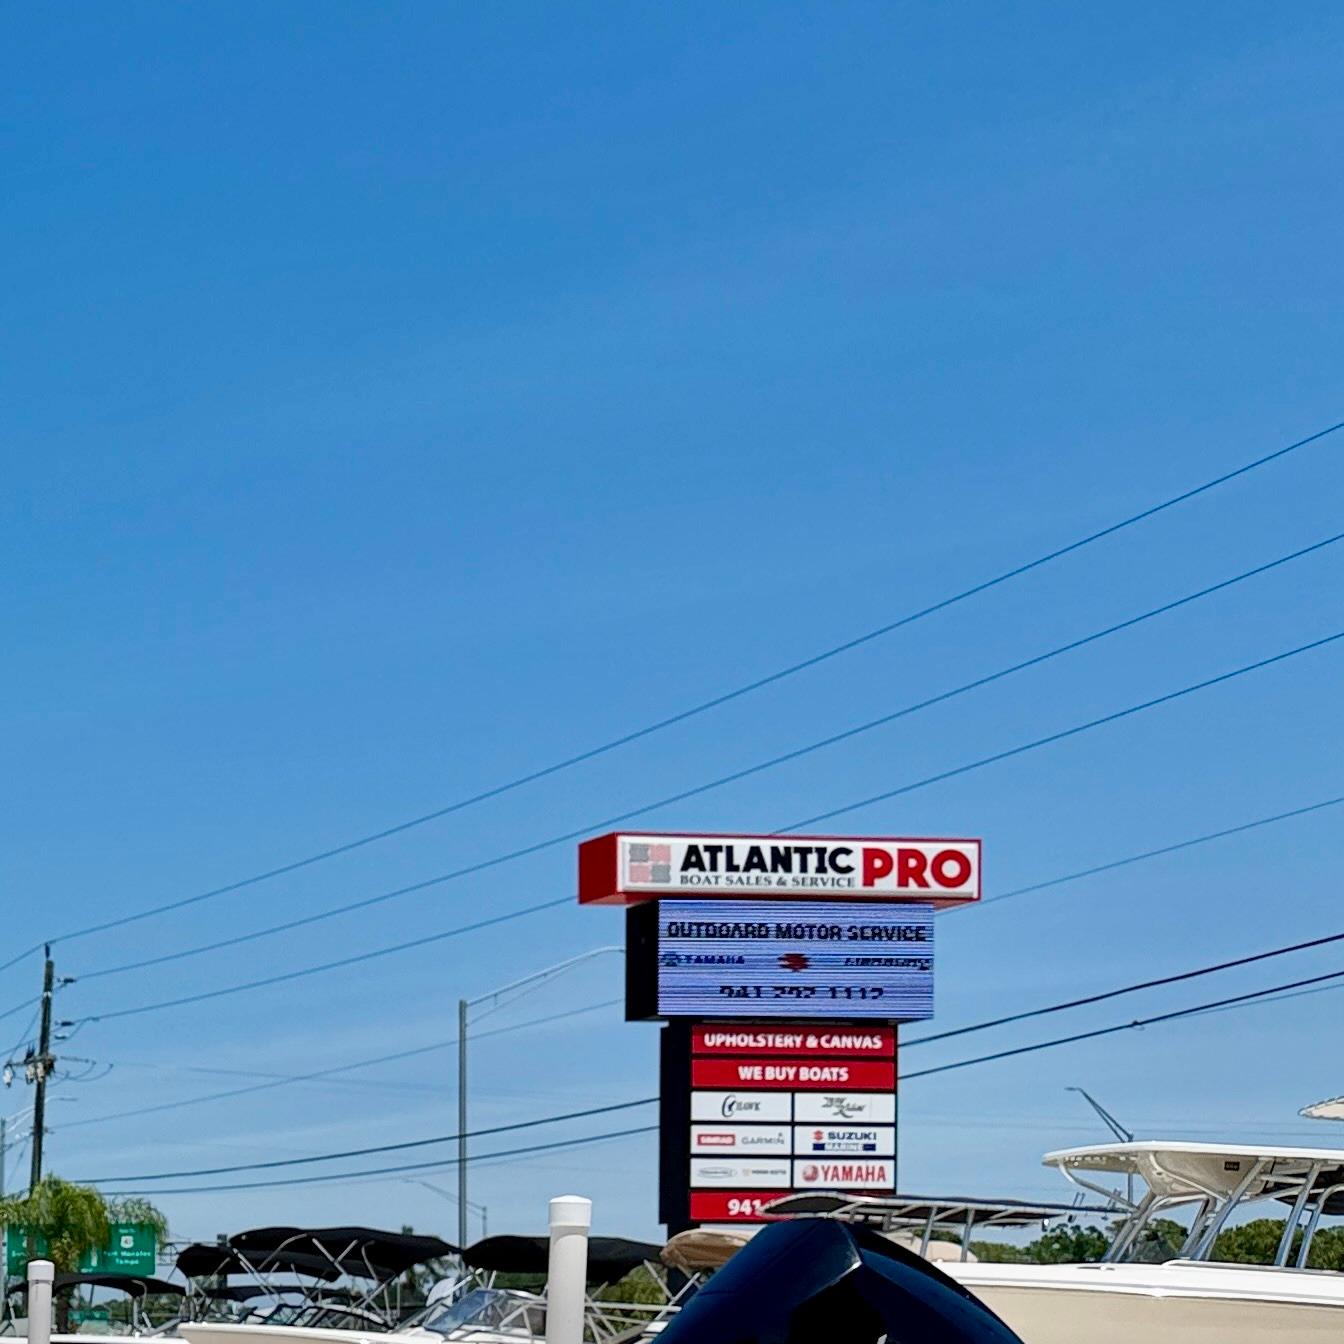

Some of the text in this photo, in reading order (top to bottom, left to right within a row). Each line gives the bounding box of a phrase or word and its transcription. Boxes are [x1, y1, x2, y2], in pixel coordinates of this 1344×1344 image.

[680, 844, 972, 889] ATLANTIC PRO
[680, 874, 855, 888] BOAT SALES & SERVICE
[775, 923, 842, 940] MOTOR
[847, 925, 927, 942] SERVICE
[704, 1033, 883, 1049] UPHOLSTERY & CANVAS
[738, 1066, 849, 1082] WE BUY BOATS
[828, 1132, 877, 1141] SUZUKI
[821, 1165, 887, 1182] YAMAHA
[727, 1199, 762, 1216] 941
